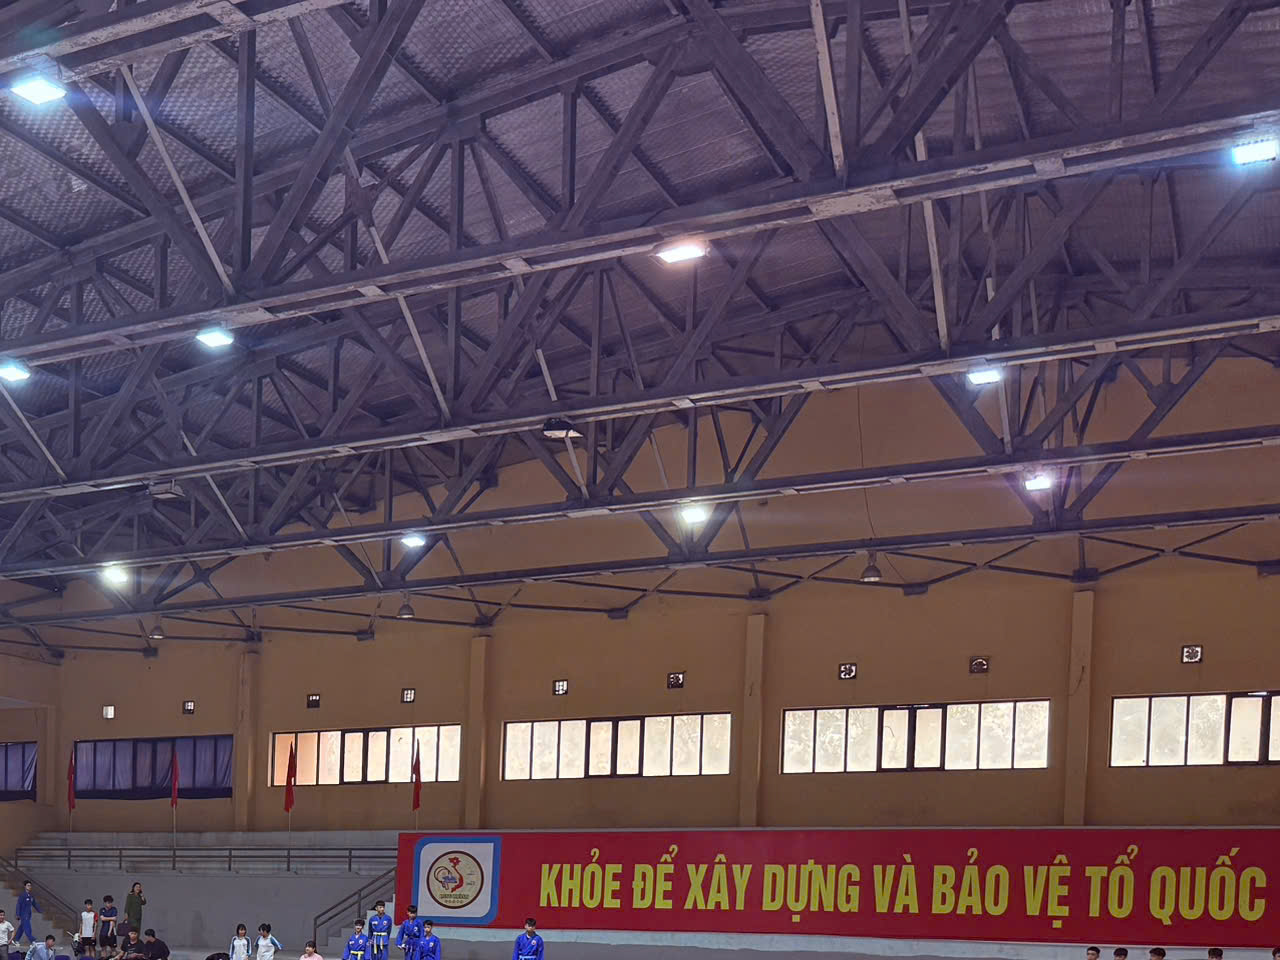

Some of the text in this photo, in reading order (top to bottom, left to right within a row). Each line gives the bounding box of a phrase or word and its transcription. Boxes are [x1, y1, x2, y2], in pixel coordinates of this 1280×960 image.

[539, 844, 1267, 928] KHỎE ĐỂ XÂY DỰNG VÀ BẢO VỆ TỔ QUỐC
